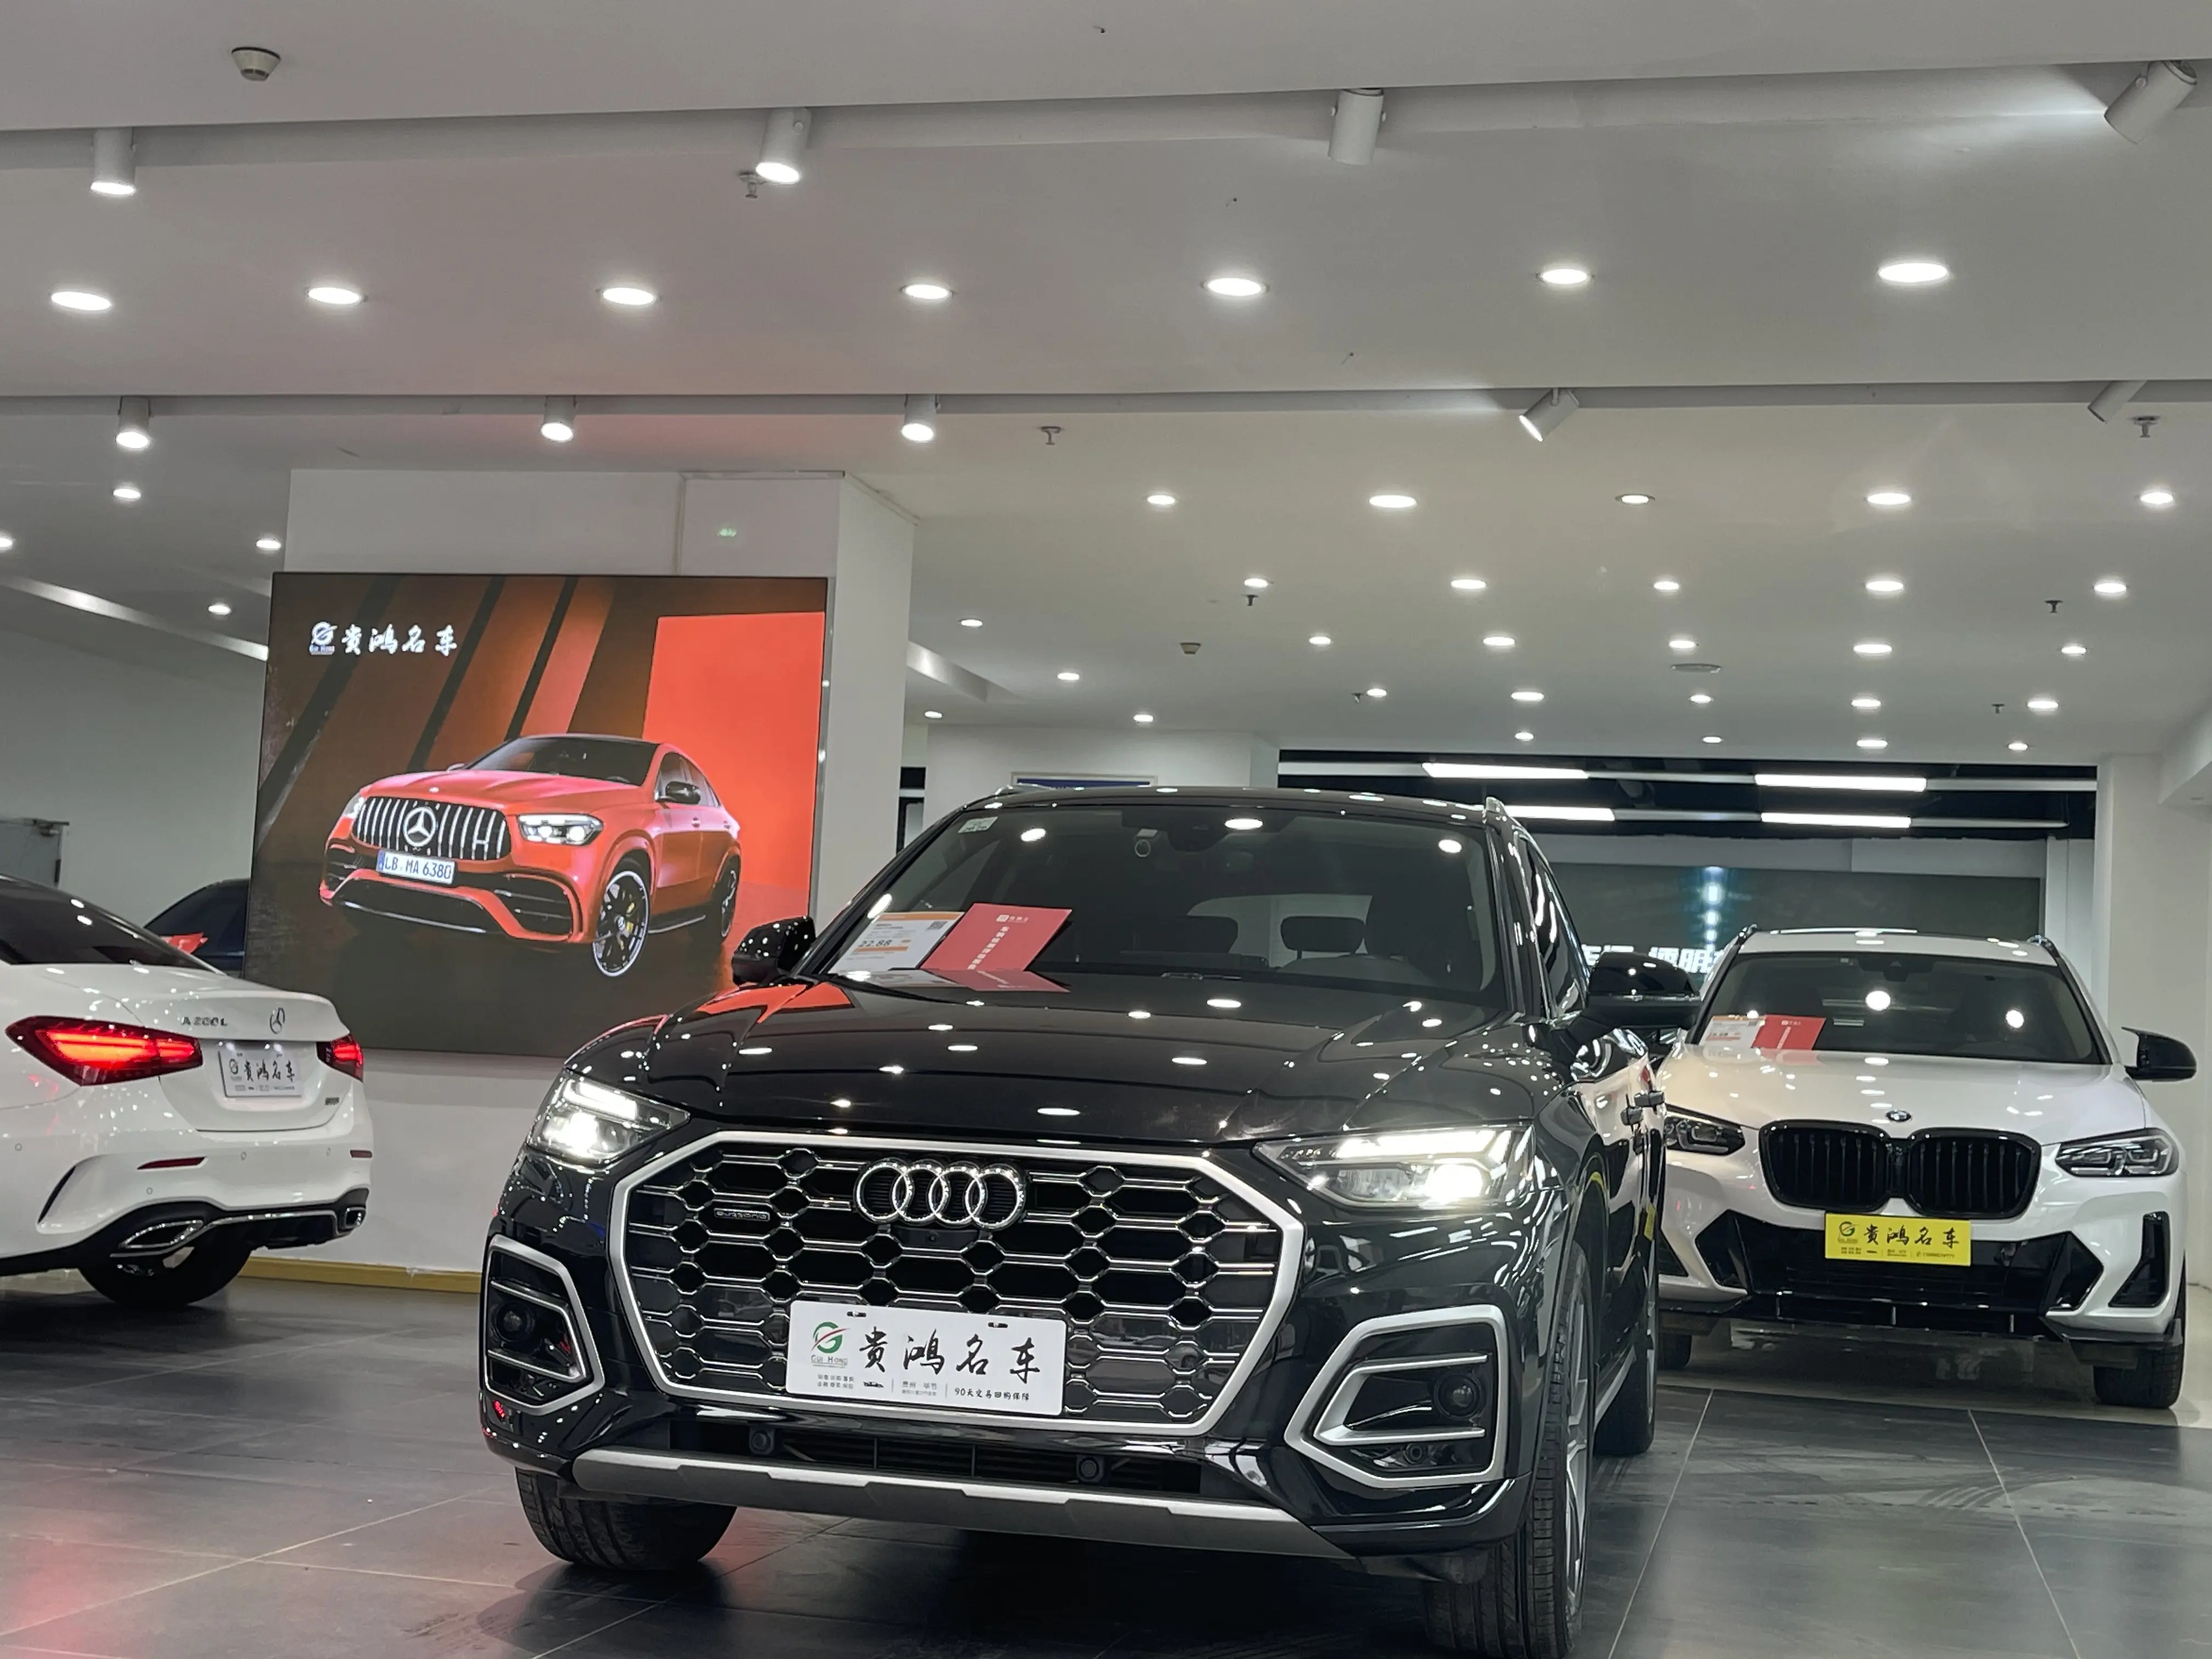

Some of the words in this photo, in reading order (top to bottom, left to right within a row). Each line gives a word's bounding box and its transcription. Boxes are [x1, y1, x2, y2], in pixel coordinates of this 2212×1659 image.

[341, 624, 457, 656] 贵鸿名车
[385, 856, 399, 871] LB
[405, 859, 419, 874] MA
[422, 862, 452, 879] 6380
[1864, 1223, 1959, 1249] 贵鸿名车
[859, 1326, 1041, 1384] 贵鸿名车
